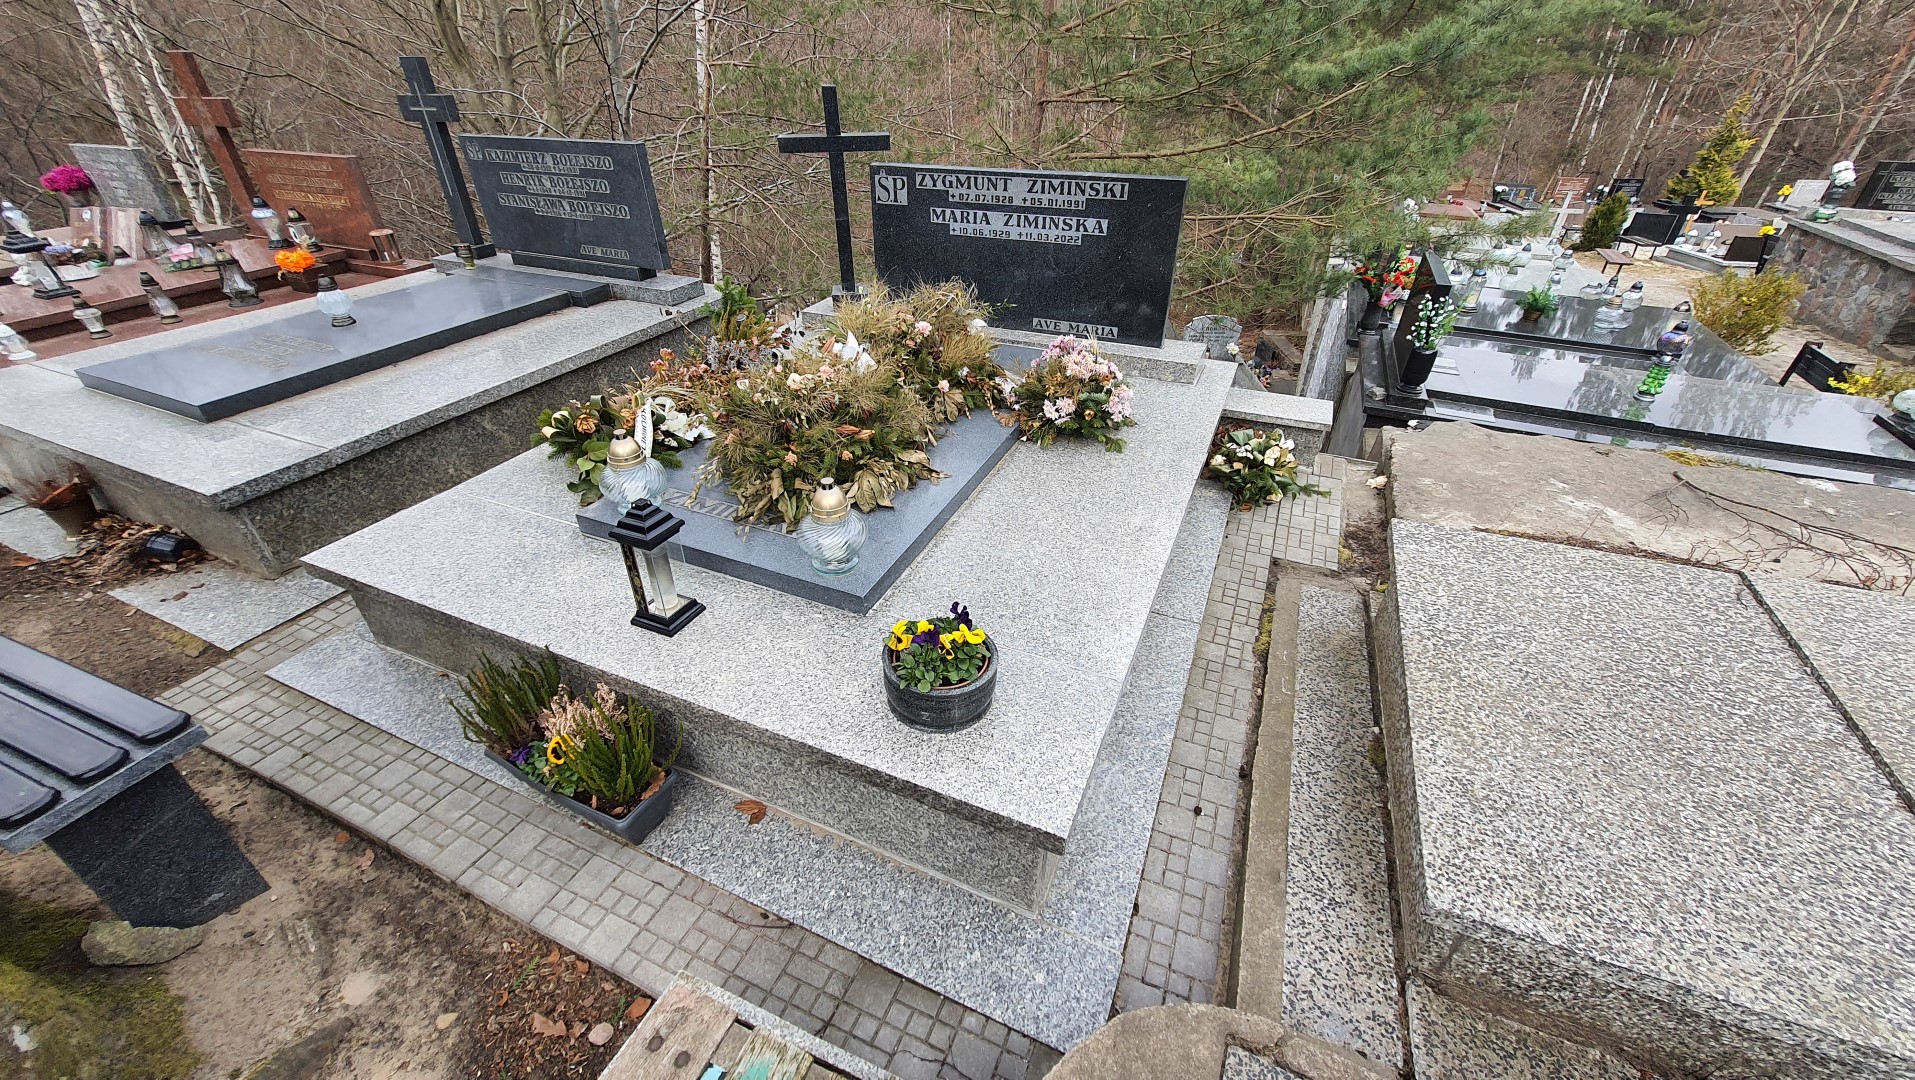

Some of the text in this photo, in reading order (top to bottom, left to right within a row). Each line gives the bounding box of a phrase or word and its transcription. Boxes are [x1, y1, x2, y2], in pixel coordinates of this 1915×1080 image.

[485, 149, 547, 165] KAZIMIERZ
[501, 172, 546, 187] HENRYK
[917, 173, 1012, 192] ZYGMUNT
[498, 193, 566, 212] STANISŁAWA
[931, 208, 991, 226] MARIA
[581, 245, 629, 259] AVE MARIA
[1034, 319, 1116, 338] AVE MARIA
